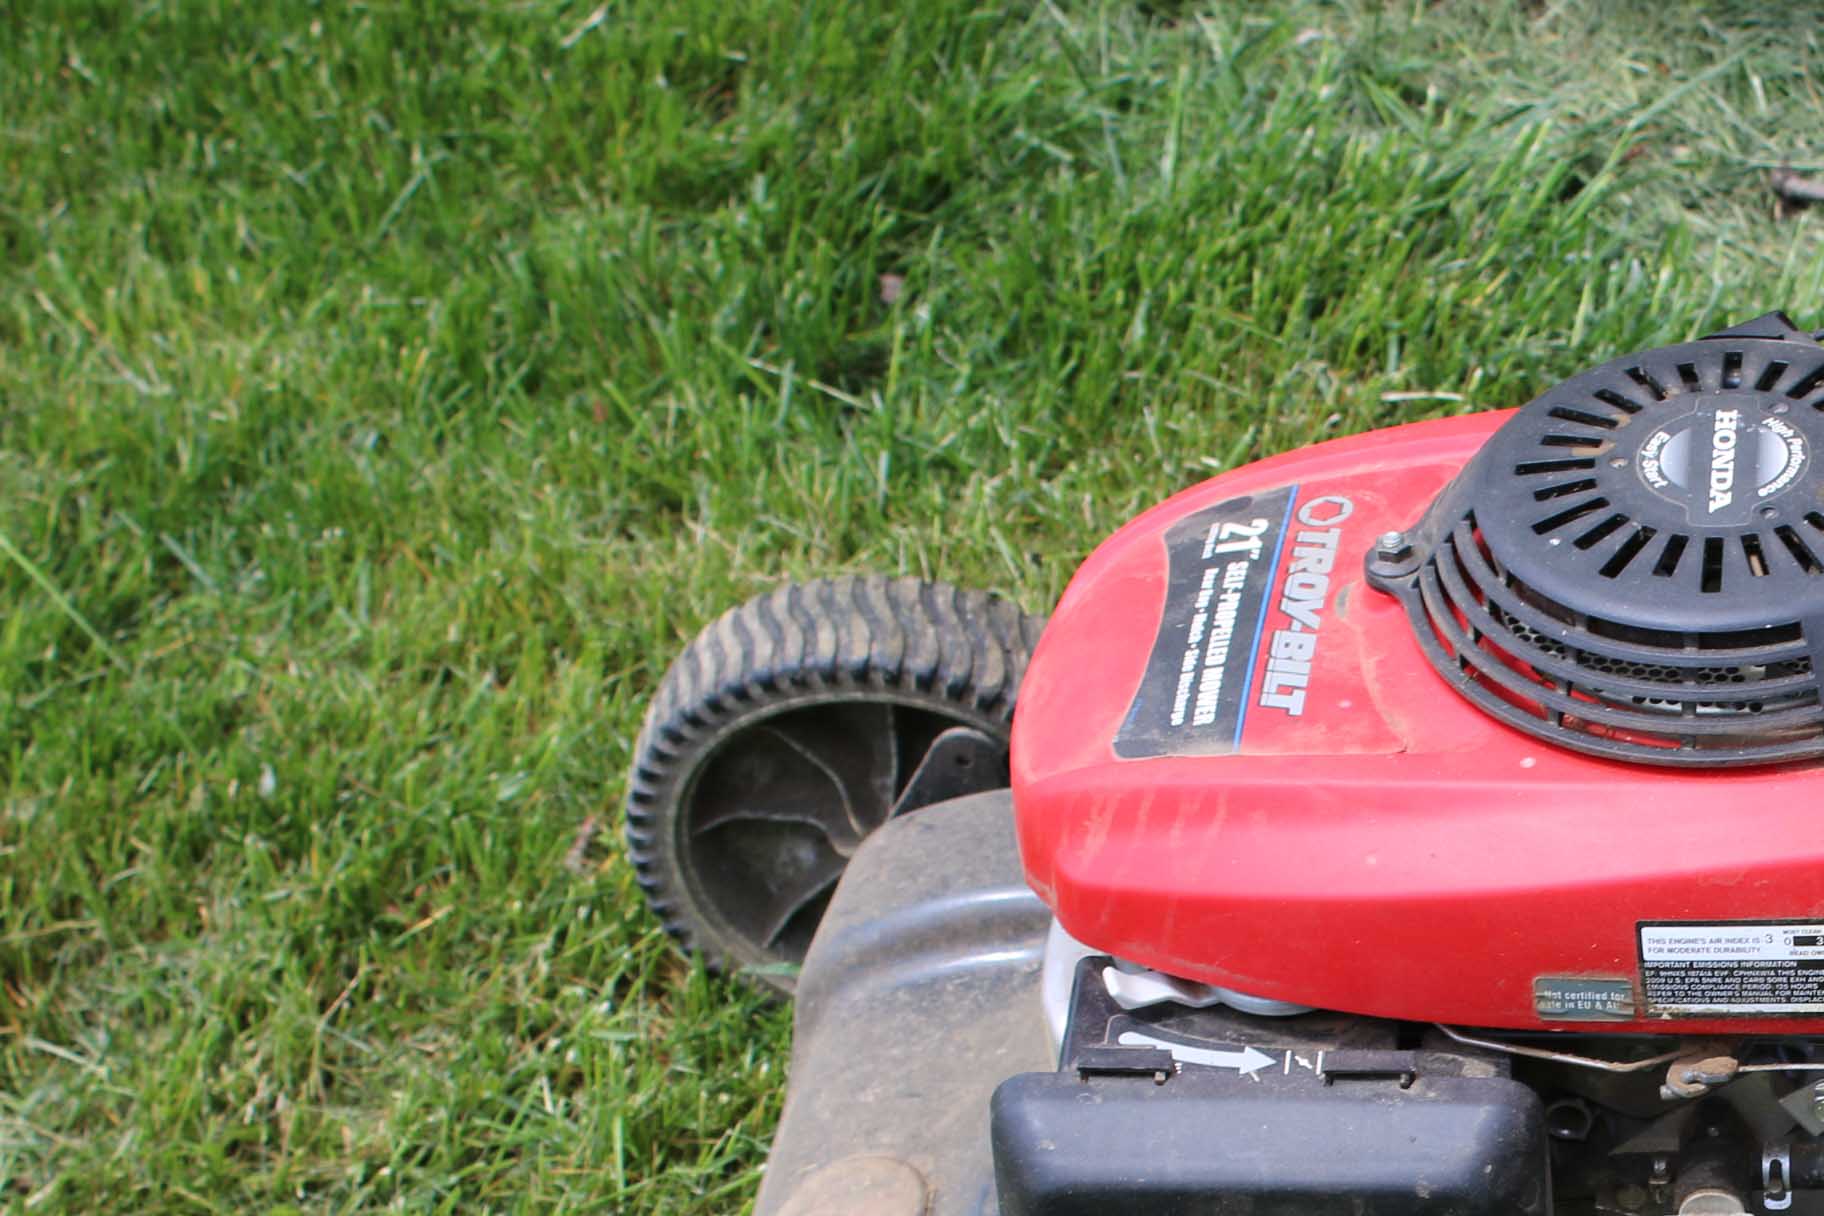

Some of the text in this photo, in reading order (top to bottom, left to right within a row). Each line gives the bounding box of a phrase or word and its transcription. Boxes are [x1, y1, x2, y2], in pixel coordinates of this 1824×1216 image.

[1641, 431, 1671, 488] Easy Start
[1708, 409, 1738, 513] HONDA
[1757, 417, 1807, 497] High Performance
[1212, 518, 1269, 559] 21"
[1200, 568, 1219, 588] Rear
[1193, 589, 1214, 608] Bag
[1203, 560, 1248, 665] SELF-PROPELLED
[1186, 613, 1208, 643] Mulch
[1260, 527, 1341, 717] TROY-BILT
[1180, 649, 1199, 671] Side
[1168, 671, 1195, 725] Discharge
[1191, 666, 1224, 725] MOWER
[1765, 934, 1773, 944] 3
[1784, 937, 1791, 945] 0
[1815, 936, 1824, 945] 3
[1565, 991, 1607, 1000] certified
[1611, 992, 1625, 1000] for
[1565, 1001, 1591, 1009] in EU
